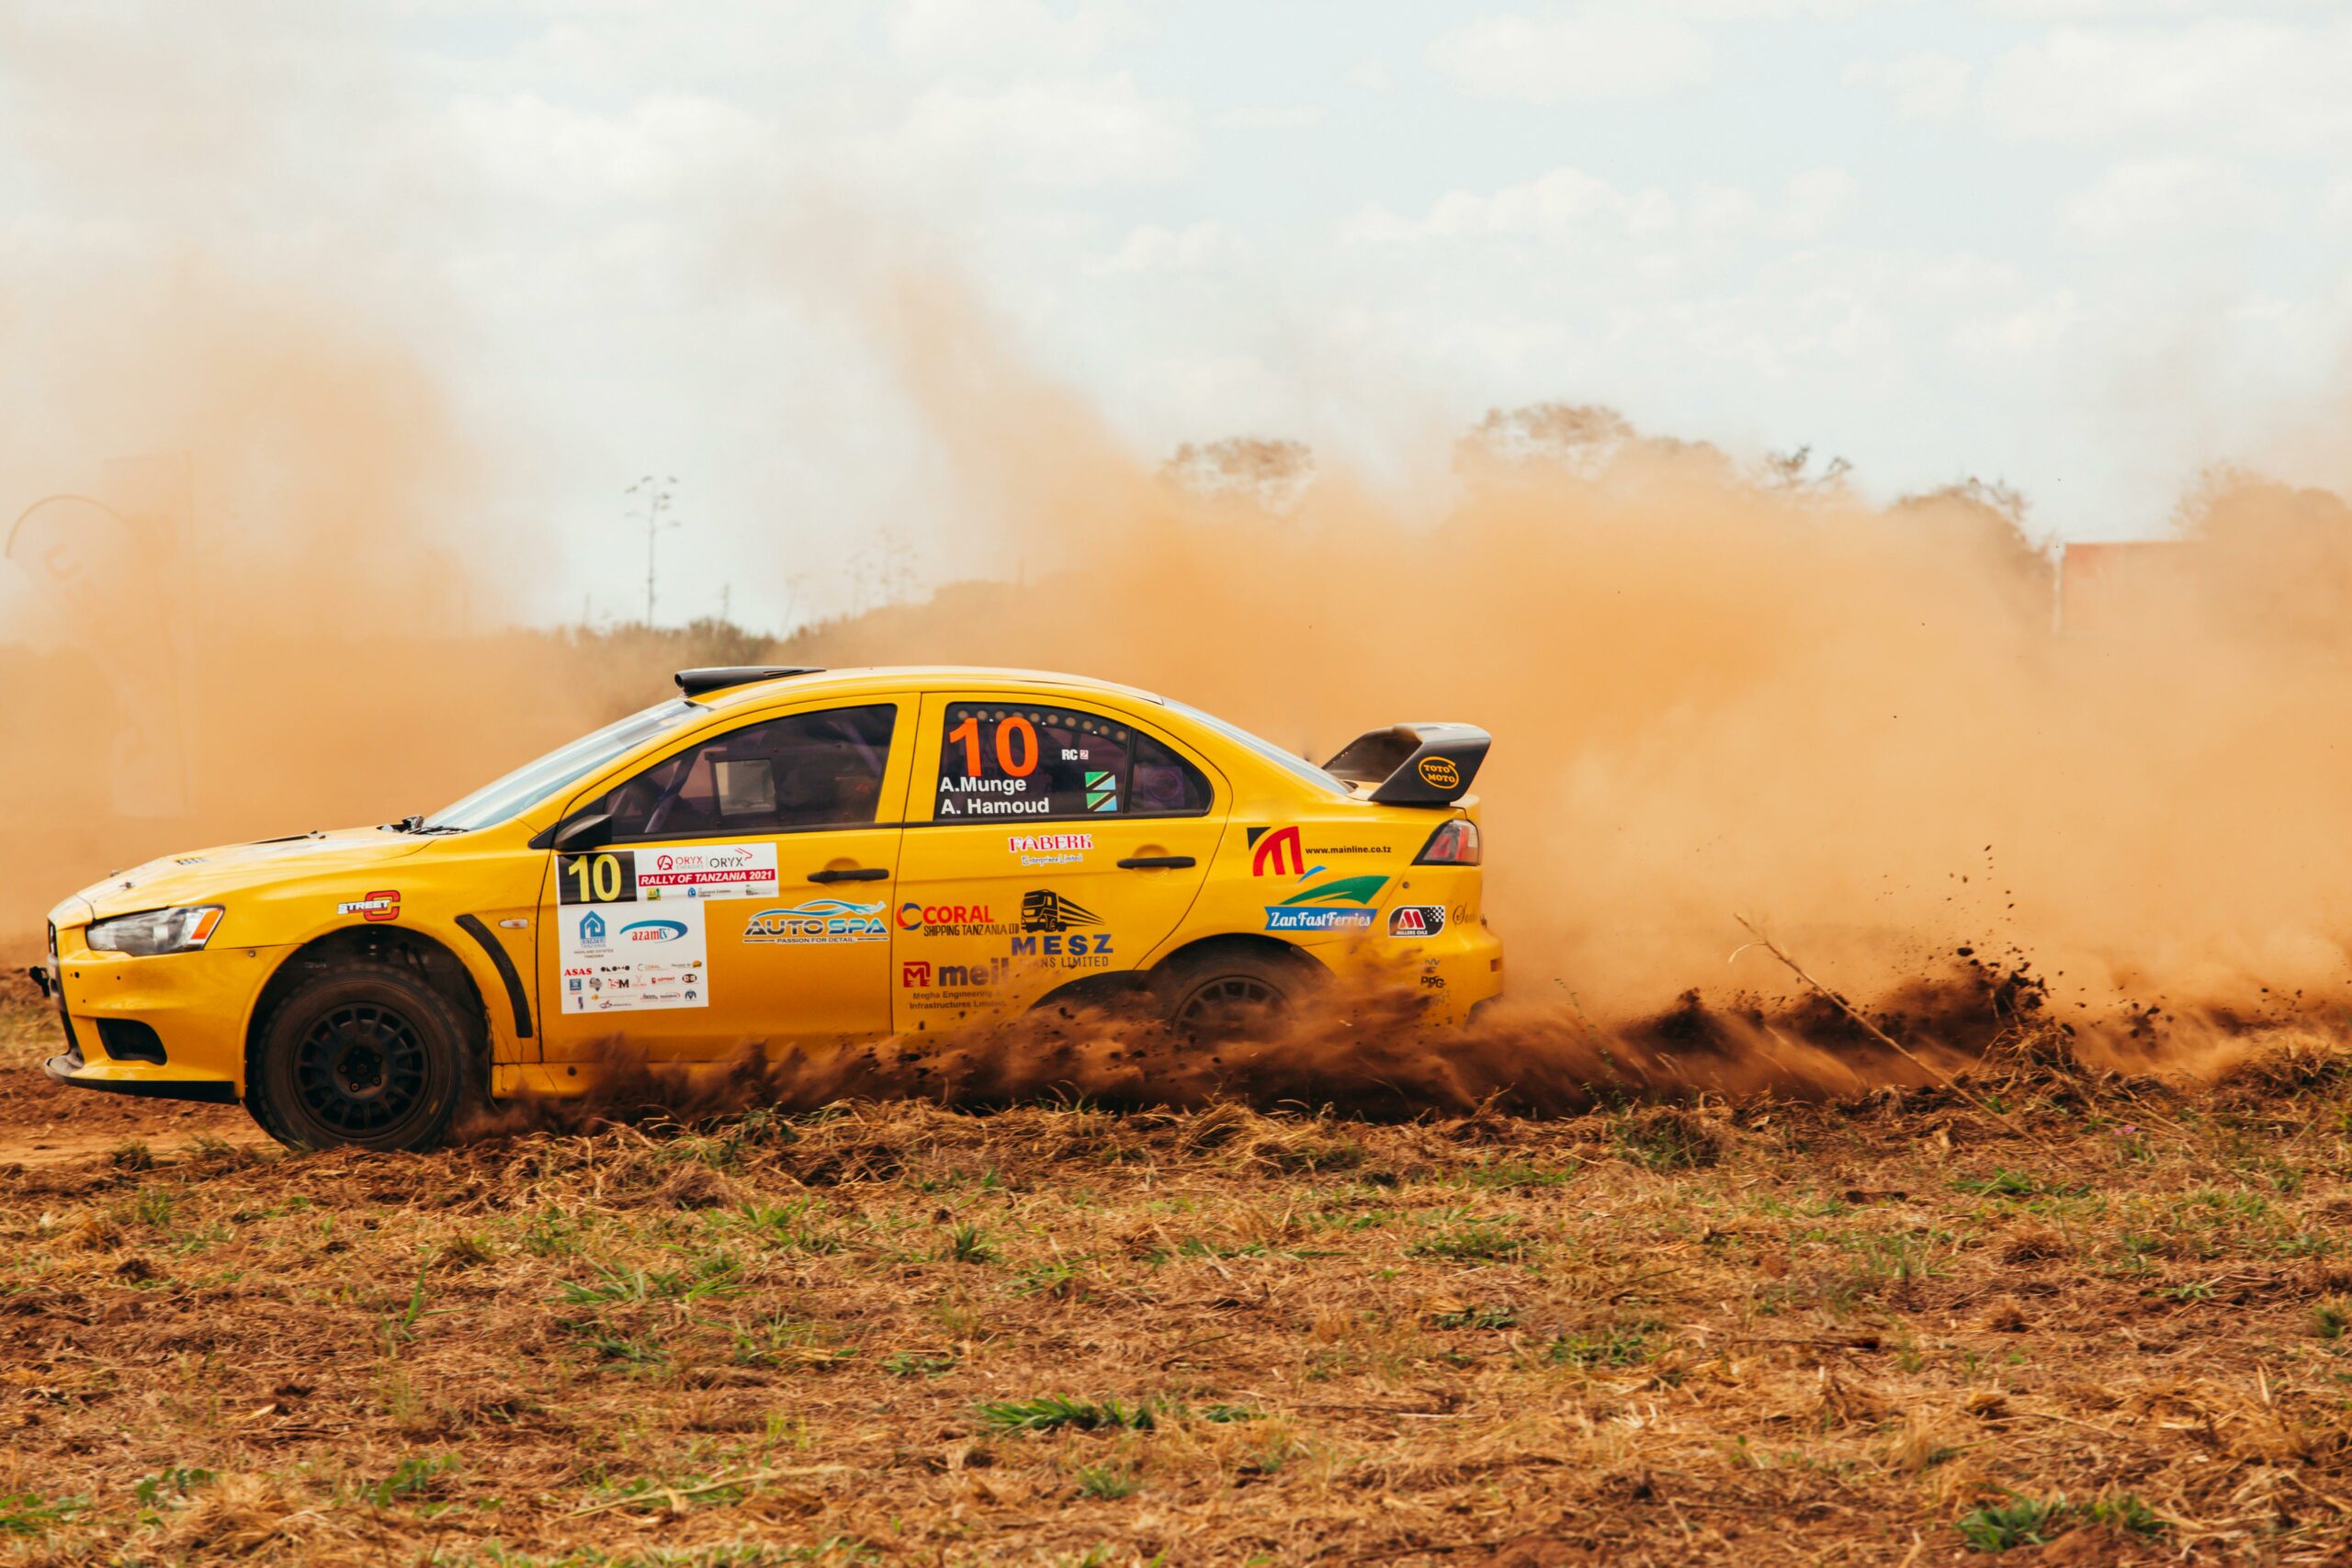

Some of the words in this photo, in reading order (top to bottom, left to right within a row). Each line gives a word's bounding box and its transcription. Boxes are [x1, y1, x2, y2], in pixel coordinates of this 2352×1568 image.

[949, 716, 1039, 777] 10
[1061, 749, 1079, 761] RC
[1423, 764, 1451, 773] TOTO
[1427, 773, 1456, 783] MOTO
[939, 776, 1027, 795] A.Munge
[941, 798, 961, 815] A.
[967, 797, 1050, 814] Hamoud
[1008, 834, 1093, 852] FABERK
[1306, 845, 1392, 854] www.mainline.co.tz
[675, 856, 704, 865] ORYX
[709, 856, 744, 868] ORYX
[568, 853, 622, 902] 10
[640, 874, 675, 886] RALLY
[677, 874, 693, 884] OF
[695, 872, 747, 883] TANZANIA
[749, 870, 772, 880] 2021
[337, 899, 390, 914] STREET
[922, 905, 995, 924] CORAL
[923, 924, 960, 936] SHIPPING
[963, 924, 1007, 936] TANZANIA
[1009, 923, 1020, 934] LTD
[1012, 934, 1114, 956] MESZ
[1060, 955, 1109, 968] LIMITED
[564, 967, 593, 976] ASAS
[912, 992, 940, 1000] Megha
[910, 1001, 971, 1010] Infrastructures
